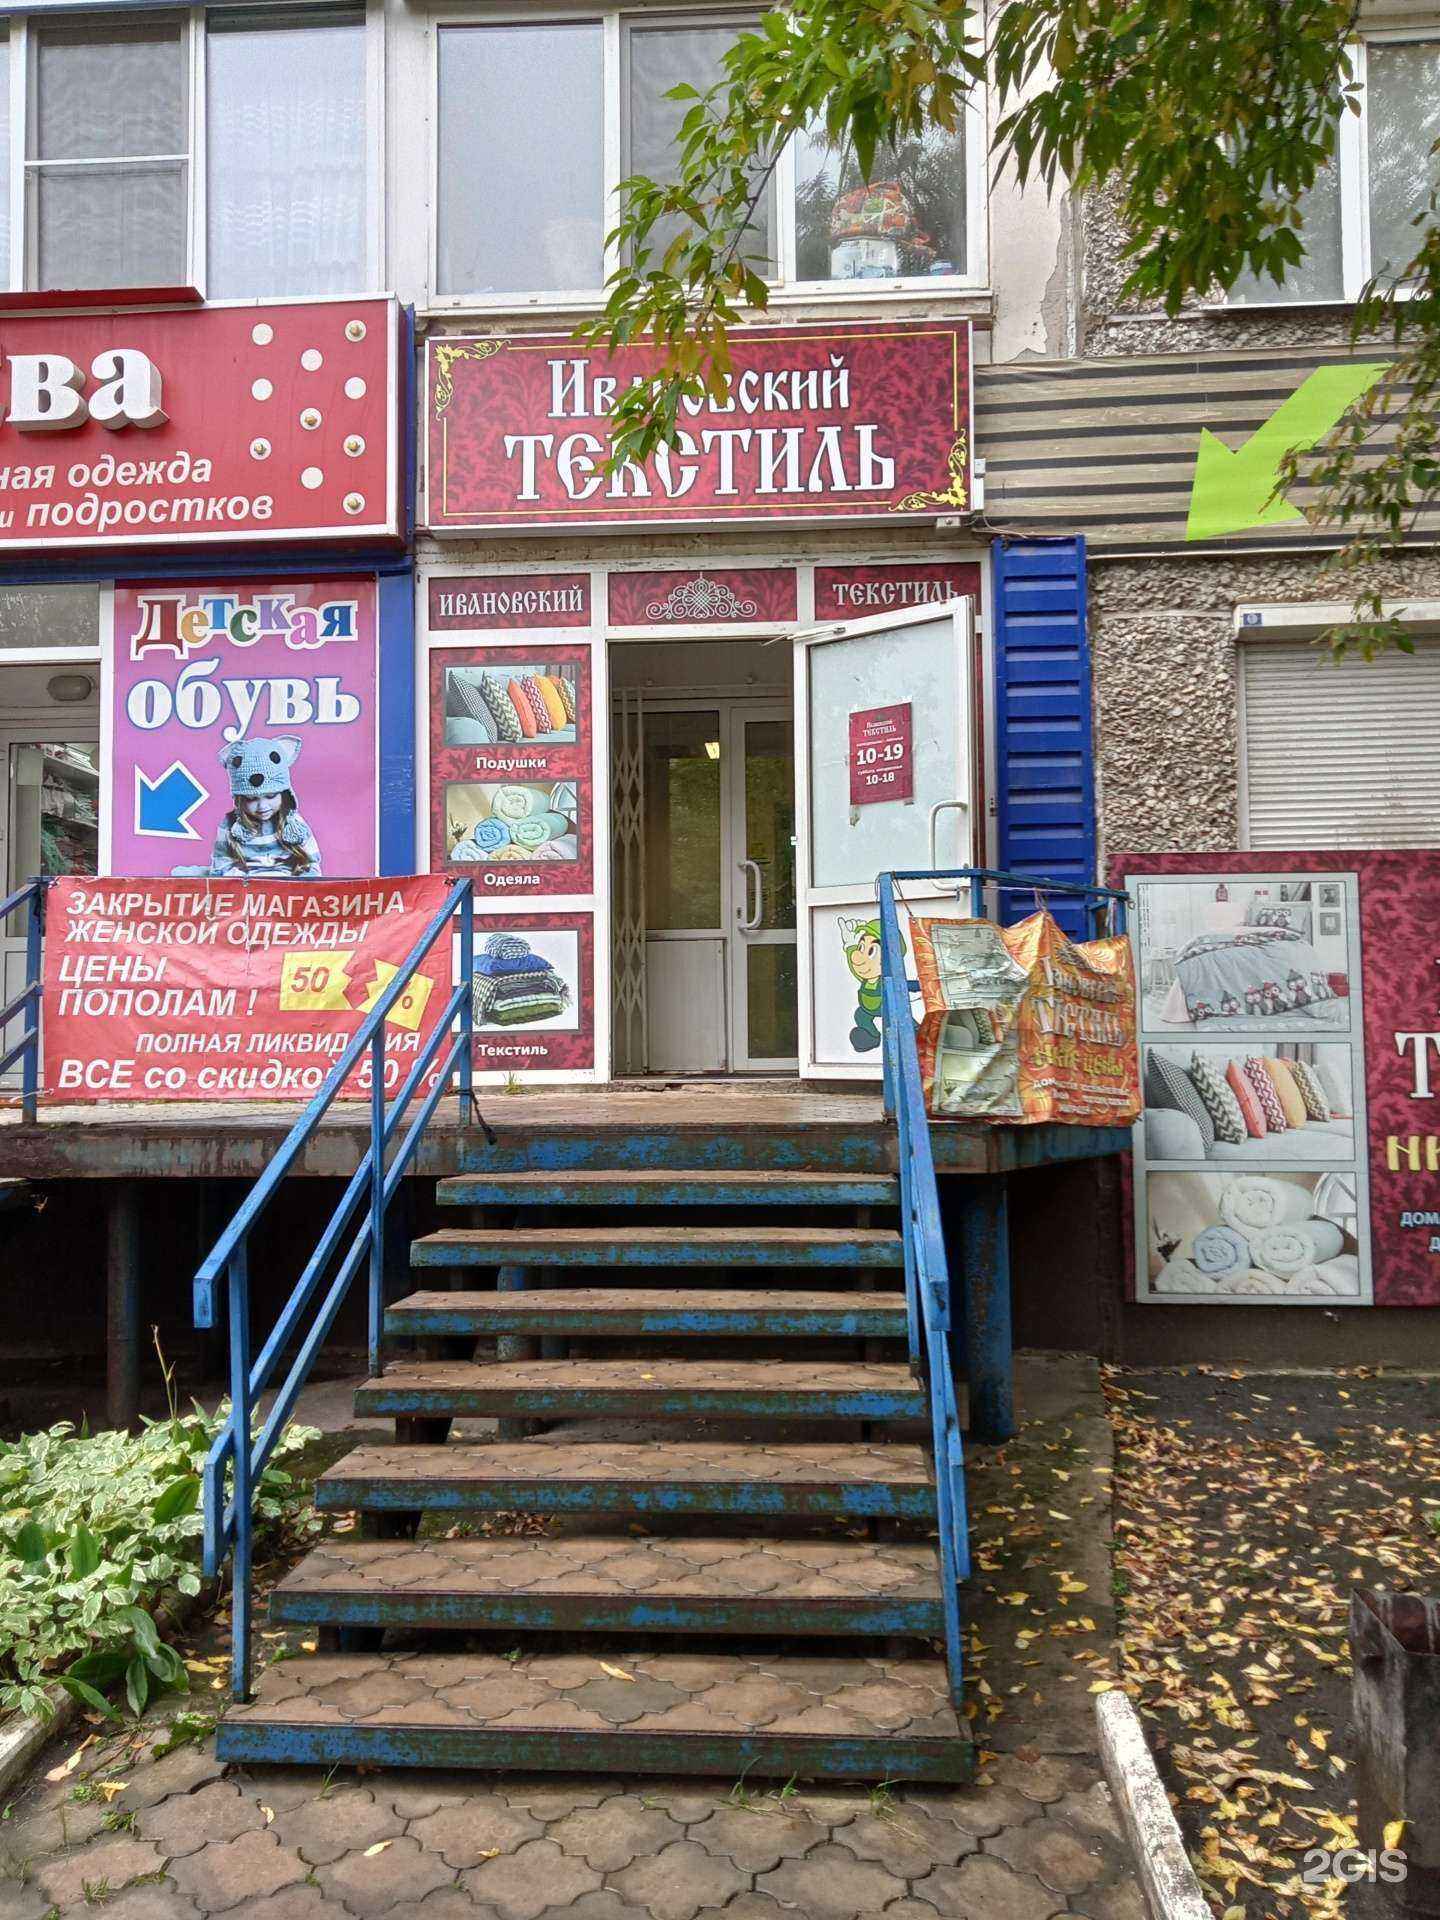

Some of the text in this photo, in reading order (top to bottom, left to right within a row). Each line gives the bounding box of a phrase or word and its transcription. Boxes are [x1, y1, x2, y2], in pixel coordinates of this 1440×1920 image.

[0, 349, 170, 430] ва
[547, 354, 850, 418] Ивовский
[67, 451, 212, 488] одежда
[503, 424, 896, 500] ТЕКСТИЛЬ
[26, 493, 273, 532] подростков
[439, 584, 583, 616] ИВАНОВСКИЙ
[833, 580, 959, 606] ТЕКСТИЛЬ
[131, 595, 358, 660] Детская
[126, 658, 361, 742] обувь
[476, 757, 547, 771] Подушки
[856, 743, 904, 766] 10-19
[865, 772, 895, 785] 10-18
[484, 873, 541, 887] Одеяла
[66, 891, 405, 918] ЗАКРЫТИЕ МАГАЗИНА
[64, 919, 368, 951] ЖЕНСКОЙ ОДЕЖДЫ
[58, 956, 165, 986] ЦЕНЫ
[290, 966, 330, 993] 50
[58, 990, 237, 1017] ПОПОЛАМ
[135, 1032, 421, 1057] ПОЛНАЯ ЛИКВИДИЯ
[478, 1044, 549, 1057] Текстиль
[59, 1059, 135, 1089] ВСЕ
[144, 1066, 186, 1089] со
